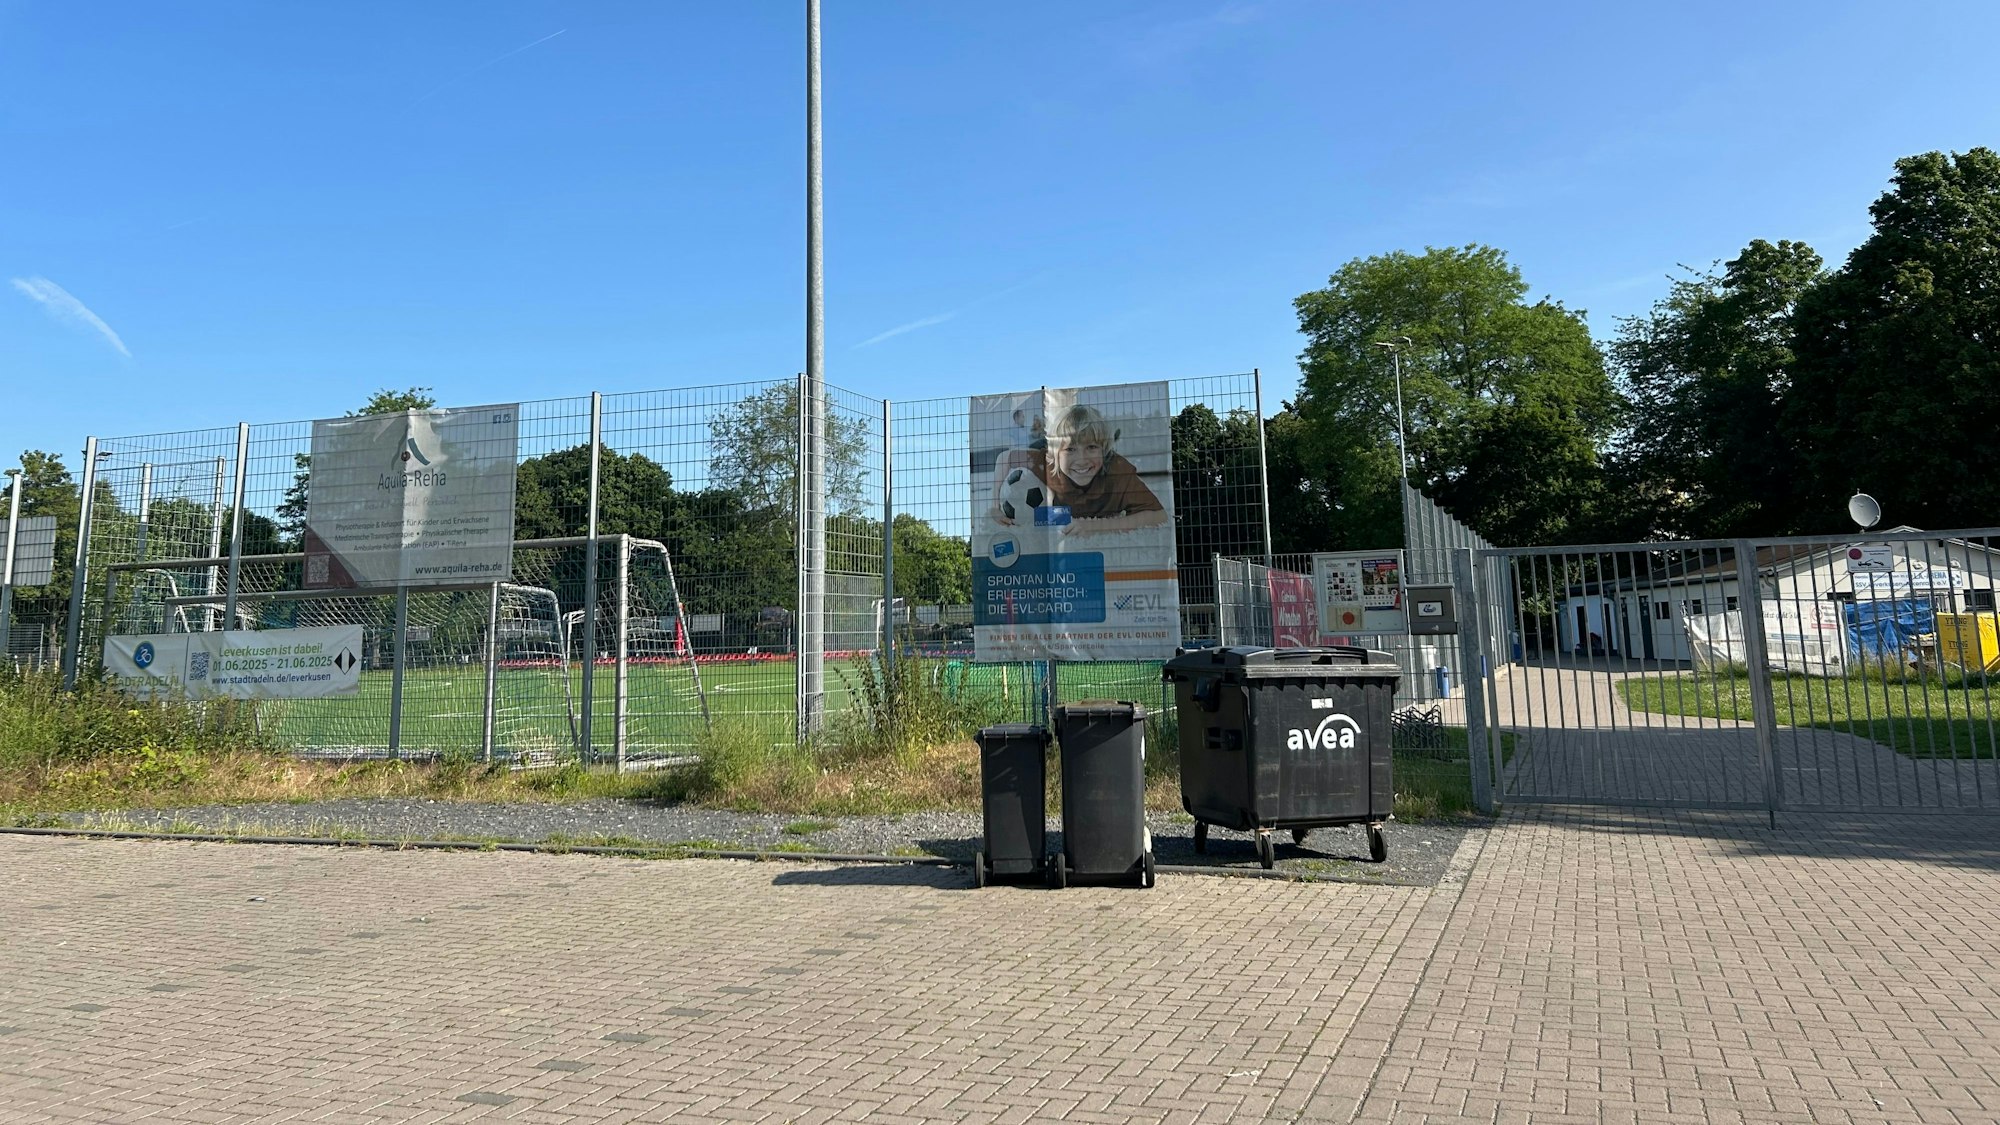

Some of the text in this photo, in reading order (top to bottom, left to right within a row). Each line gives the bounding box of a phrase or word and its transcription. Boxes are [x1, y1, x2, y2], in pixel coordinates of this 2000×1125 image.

[377, 469, 447, 494] Aquila-Reha
[335, 515, 490, 532] Physiotherapie & Rehasport für Kinder und Erwachsene
[334, 533, 370, 542] Medizinische
[421, 529, 462, 537] Physikalische
[463, 527, 489, 537] Therapie
[353, 544, 382, 552] Ambulante
[421, 540, 440, 549] (EAP)
[415, 561, 503, 575] www.aquila-reha.de
[987, 572, 1076, 587] SPONTAN UND
[987, 587, 1089, 601] ERLEBNISREICH:
[988, 603, 1008, 615] DIE
[1133, 593, 1168, 611] EVL
[1945, 617, 1968, 625] YTNG
[989, 630, 1170, 642] FINDEN SIE ALLE PARTNER DER EVL ONLINE!
[219, 642, 323, 658] Leverkusen ist dabei!
[212, 658, 268, 672] 01.06.2025
[276, 655, 333, 669] 21.06.2025
[212, 672, 331, 685] www.stadtradeln.de/leverkusen
[1287, 716, 1359, 750] avea
